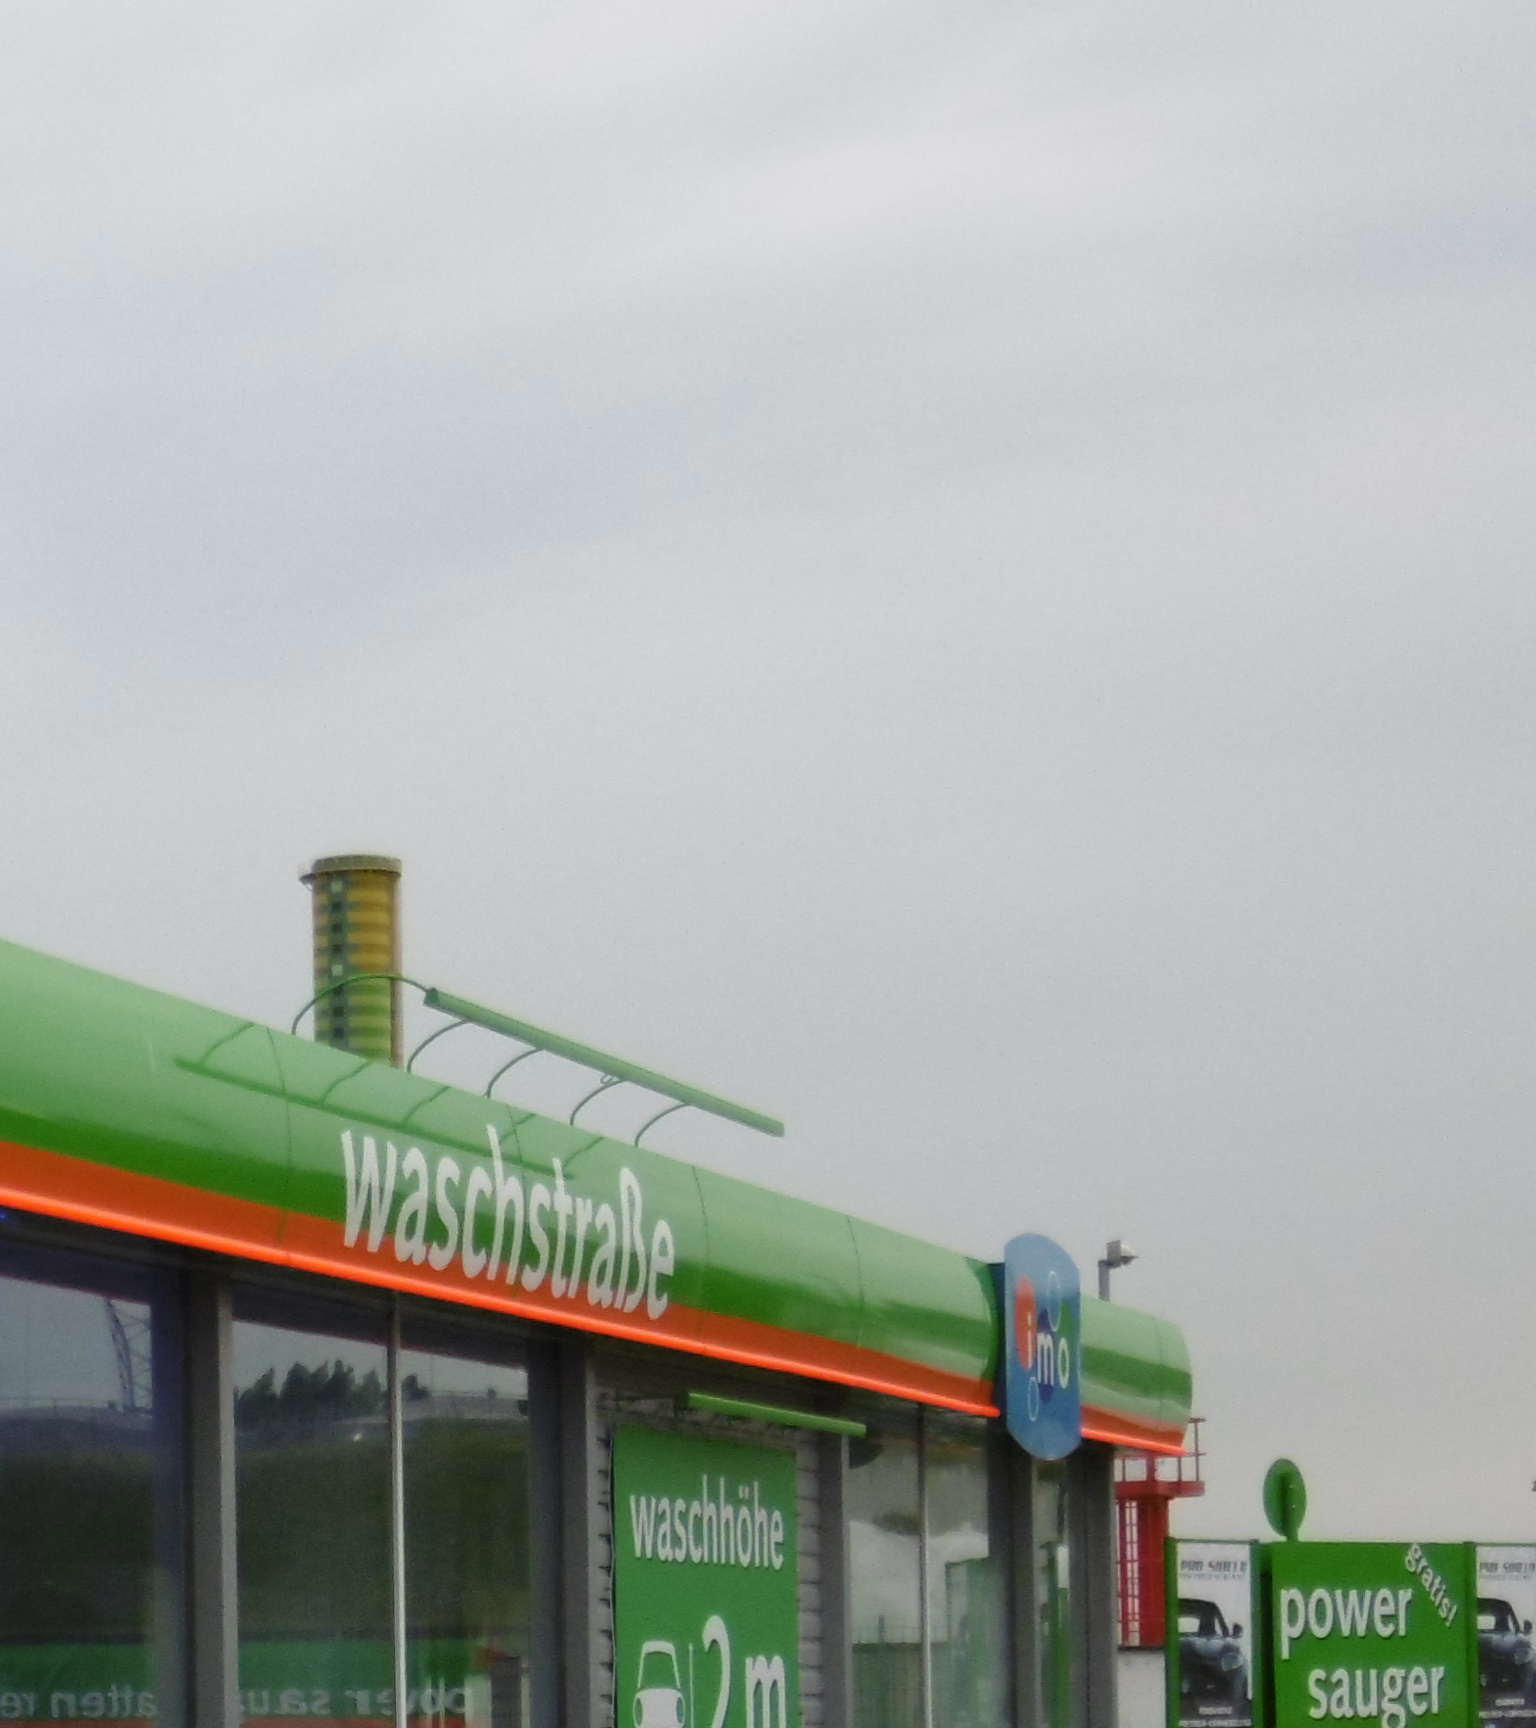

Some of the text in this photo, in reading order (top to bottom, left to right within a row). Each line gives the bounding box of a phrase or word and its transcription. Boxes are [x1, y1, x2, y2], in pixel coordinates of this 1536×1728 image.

[340, 1124, 675, 1321] waschstraße
[1027, 1311, 1070, 1389] imo
[629, 1474, 784, 1571] waschhöhe
[1280, 1588, 1413, 1660] power
[1405, 1542, 1458, 1628] gratis!
